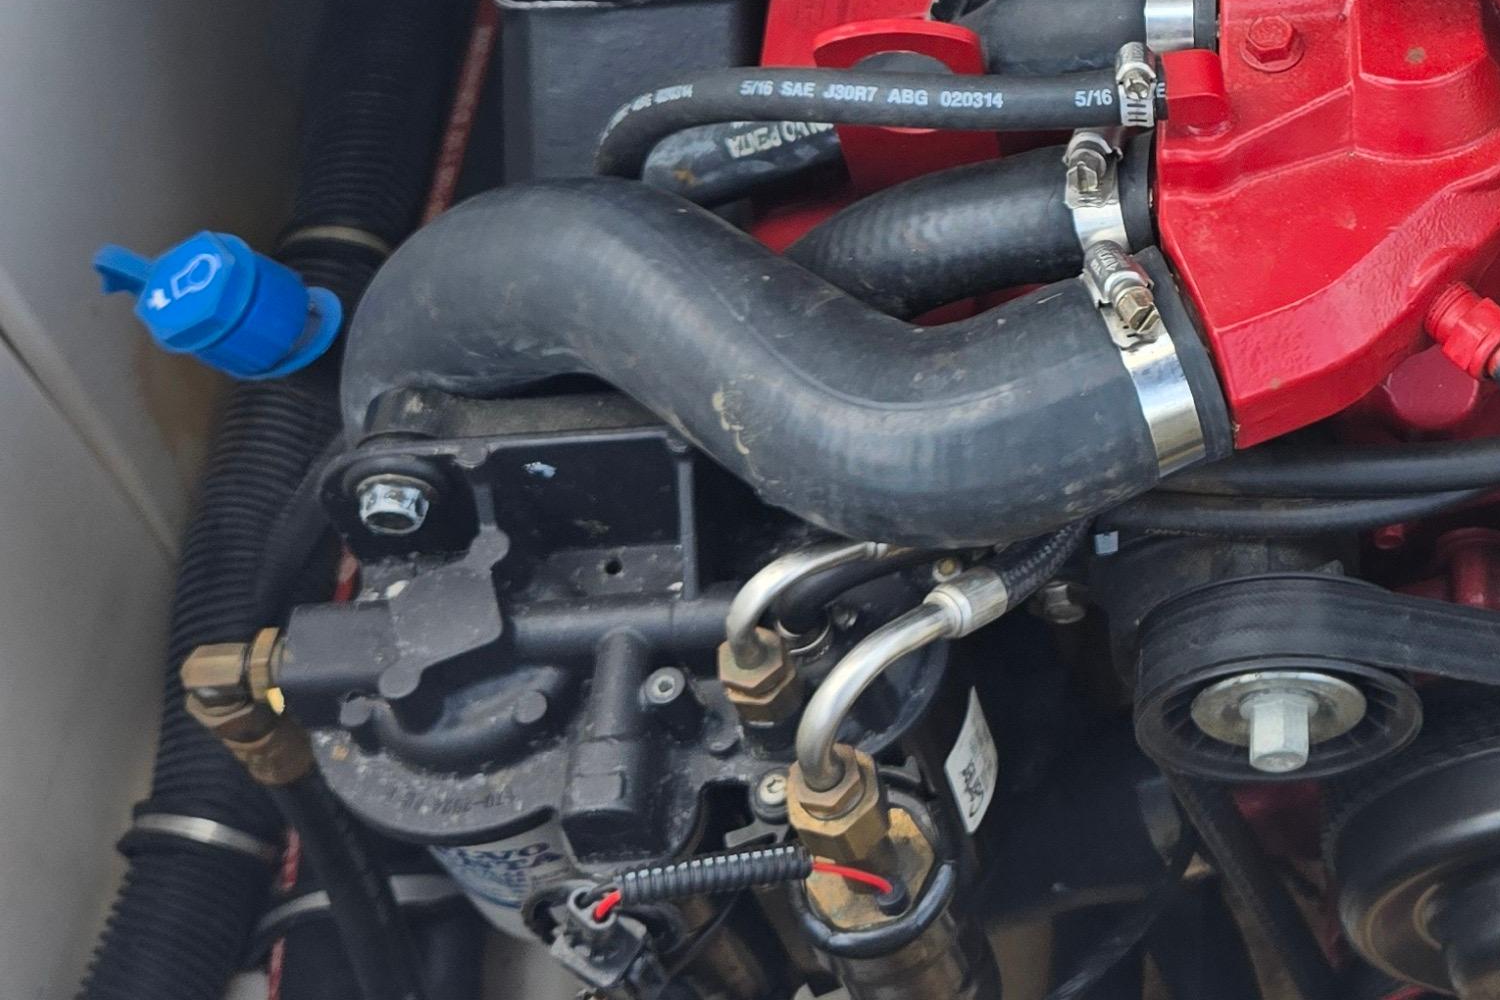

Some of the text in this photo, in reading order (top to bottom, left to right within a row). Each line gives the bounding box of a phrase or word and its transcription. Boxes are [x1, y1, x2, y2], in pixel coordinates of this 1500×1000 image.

[740, 80, 1113, 109] 5/16 SAE J30R7 ABG 020314 5/16
